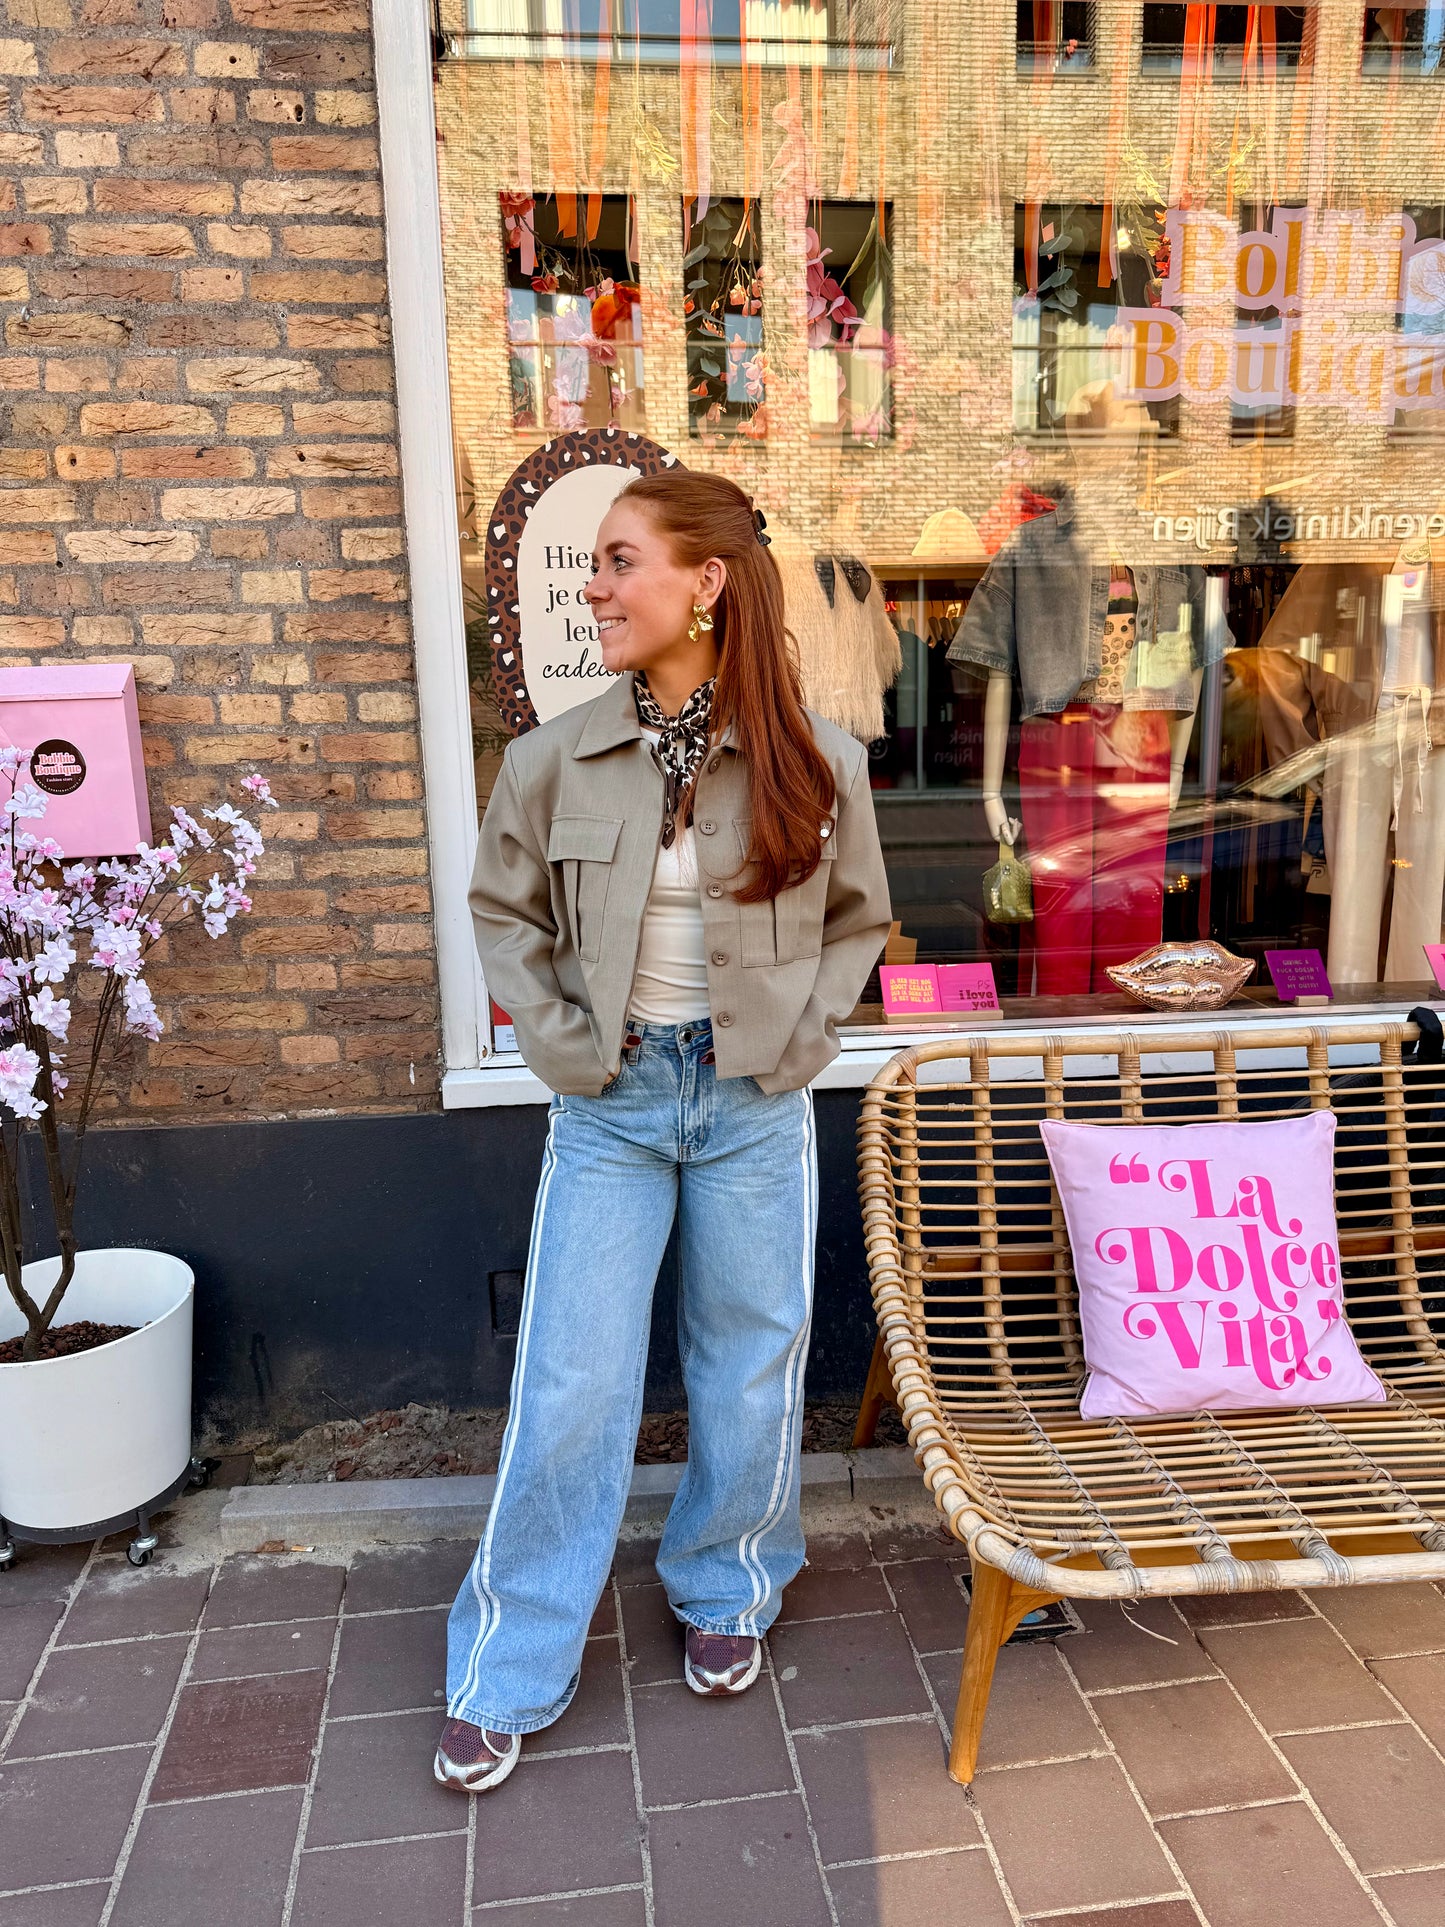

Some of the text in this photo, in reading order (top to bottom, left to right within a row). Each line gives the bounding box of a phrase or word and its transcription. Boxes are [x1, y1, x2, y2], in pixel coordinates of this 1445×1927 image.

[1129, 319, 1445, 412] Boutiqu
[544, 545, 593, 569] Hie
[545, 583, 570, 614] je
[564, 618, 600, 642] leu
[34, 764, 82, 776] Boutique
[38, 753, 75, 765] Bobbie
[959, 990, 994, 1000] i love
[972, 1000, 995, 1011] you
[1094, 1224, 1337, 1313] Dolce
